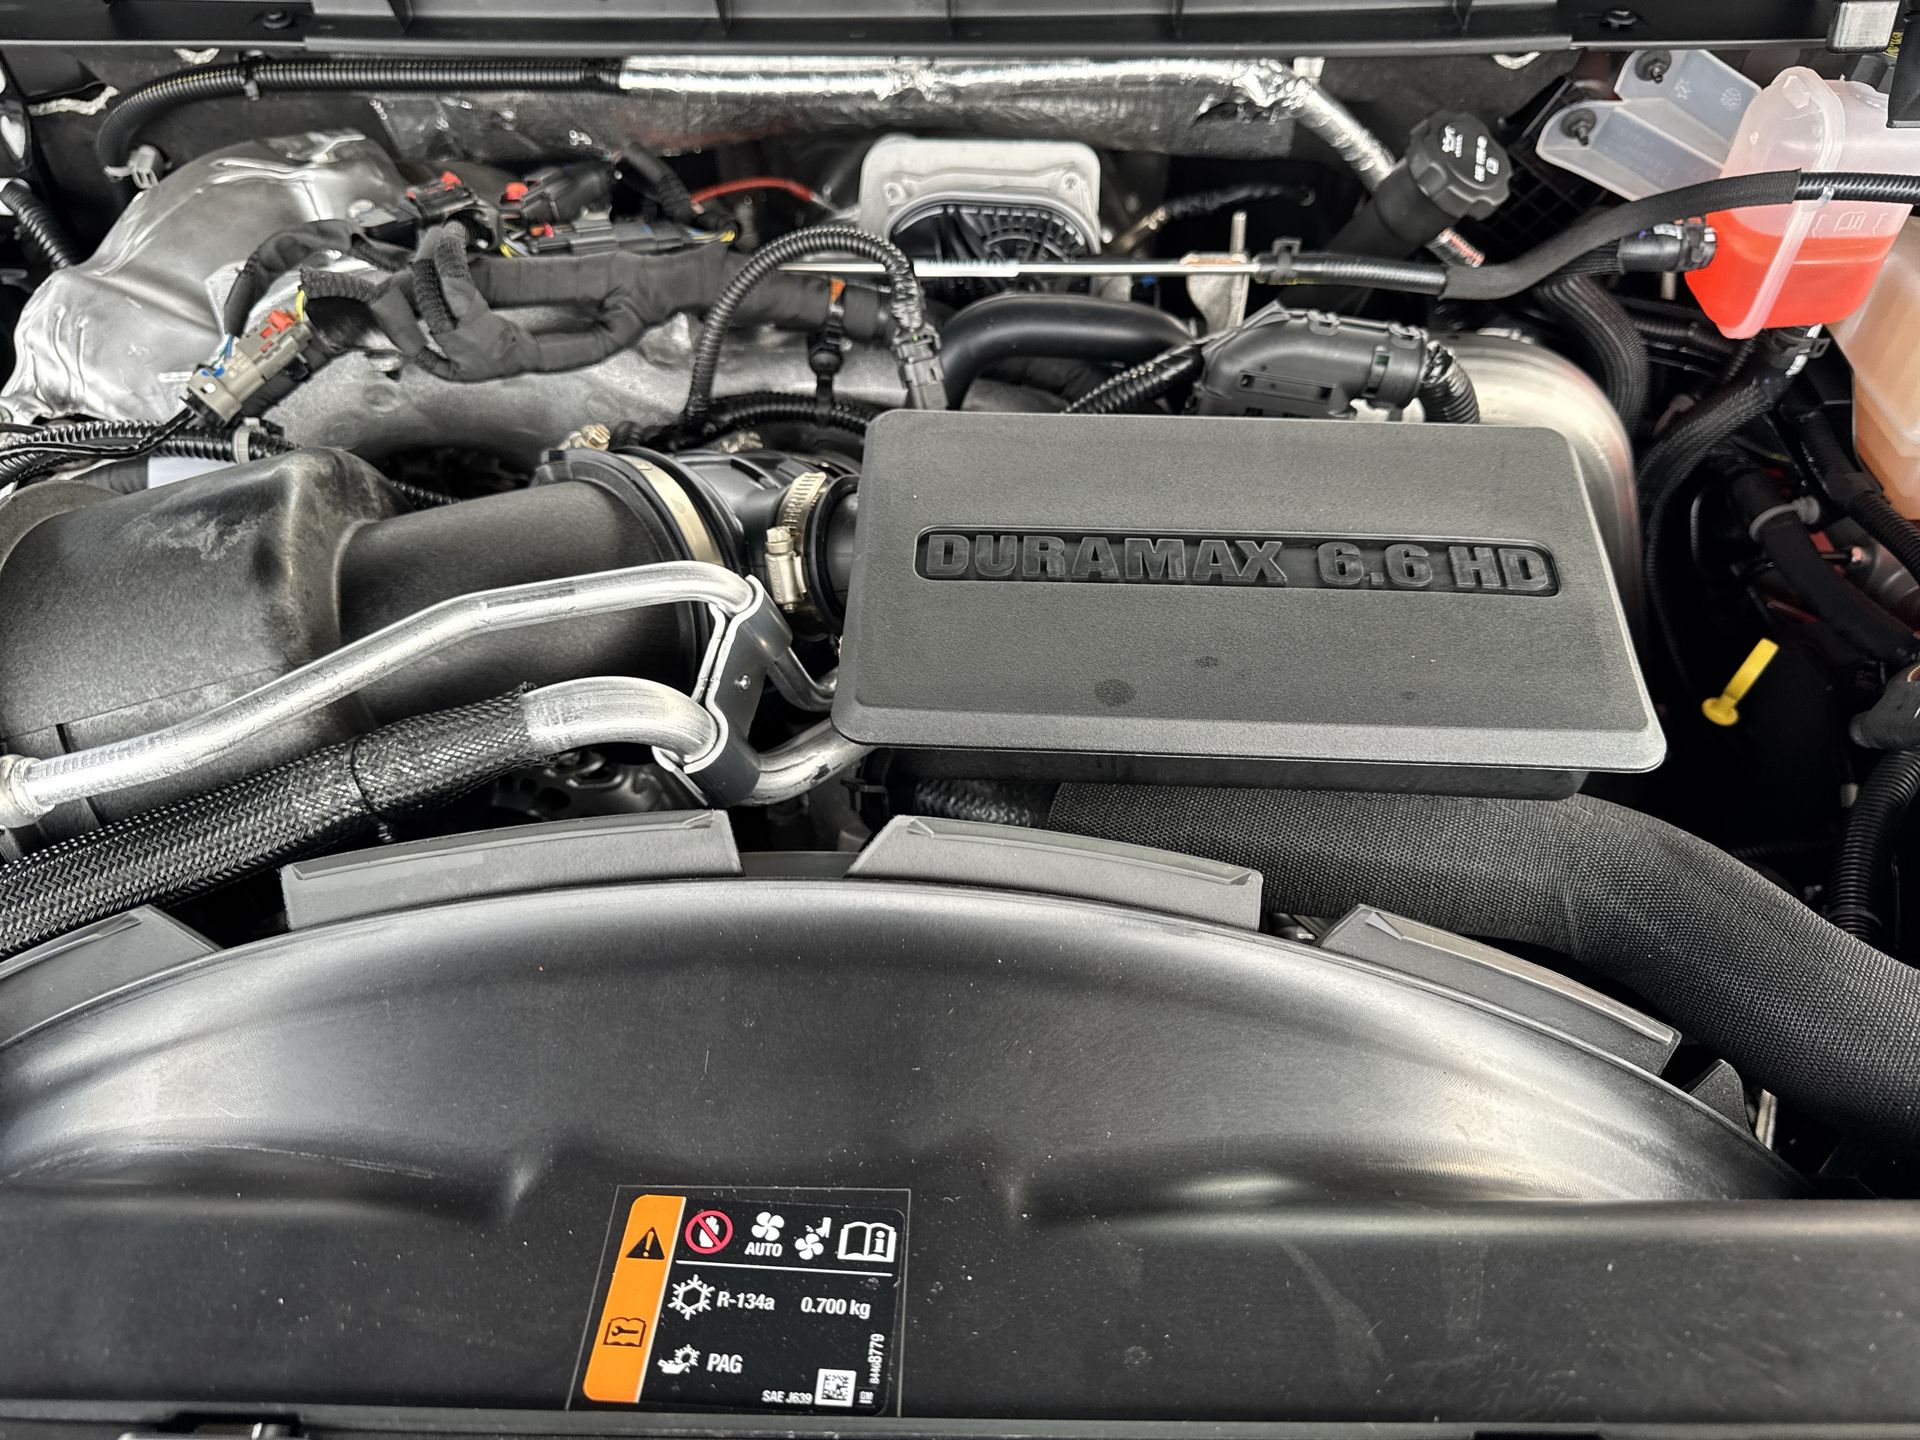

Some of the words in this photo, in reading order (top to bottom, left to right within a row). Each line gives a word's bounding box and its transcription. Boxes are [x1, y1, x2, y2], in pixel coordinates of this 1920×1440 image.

[926, 534, 1288, 582] DURAMAX
[1316, 541, 1433, 587] 6.6
[1448, 545, 1549, 591] HD
[744, 1241, 783, 1258] AUTO
[716, 1291, 776, 1311] R-134a
[800, 1296, 847, 1315] 0.700
[849, 1299, 872, 1320] kg
[706, 1352, 744, 1374] PAG
[761, 1389, 785, 1403] SAE
[785, 1391, 813, 1405] J639
